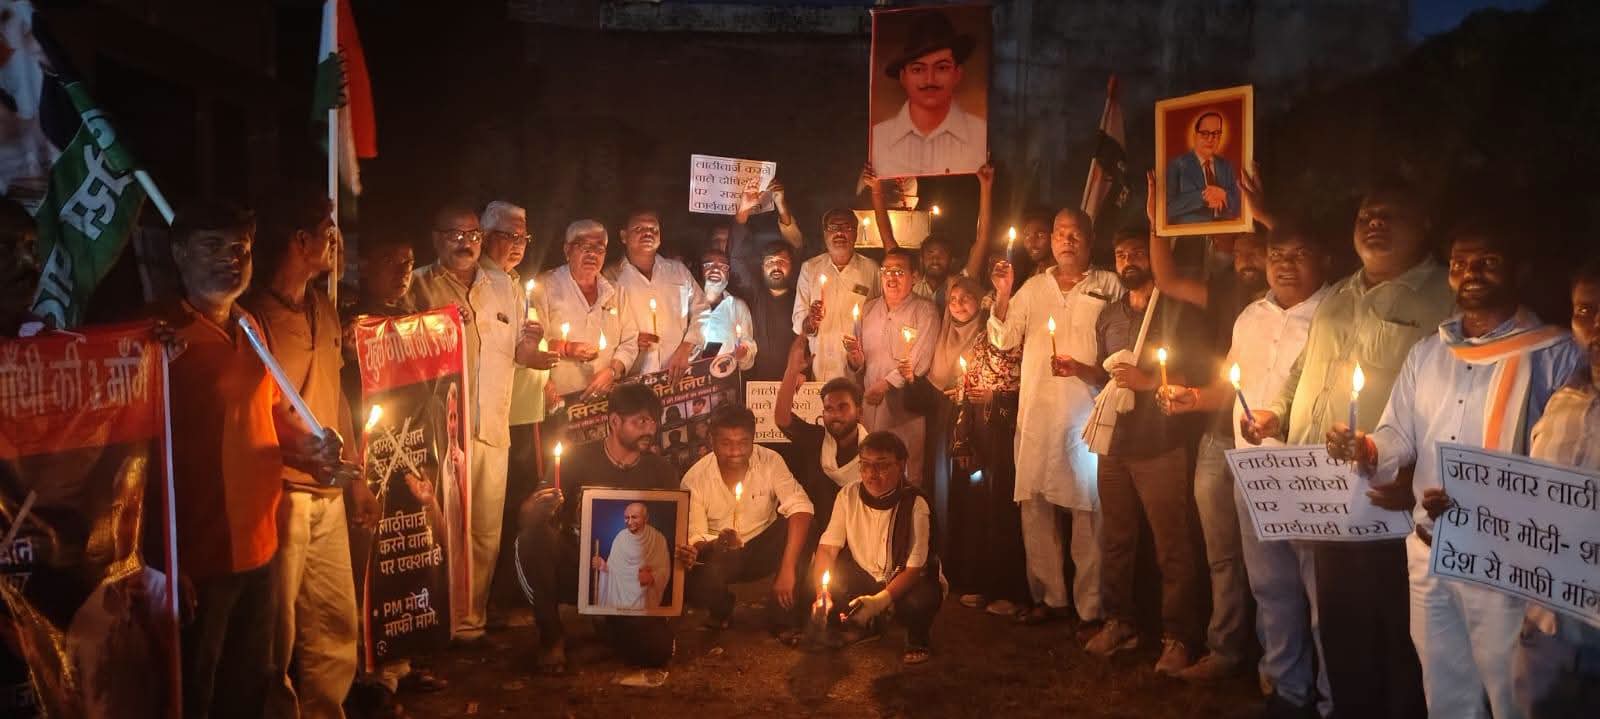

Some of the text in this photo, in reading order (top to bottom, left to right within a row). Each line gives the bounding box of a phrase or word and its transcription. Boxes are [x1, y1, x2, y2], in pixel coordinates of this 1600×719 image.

[1238, 452, 1317, 470] लाठीचार्ज
[1246, 475, 1349, 492] वाले दोषियों
[1447, 453, 1490, 486] जंतर
[1497, 463, 1540, 497] मंतर
[378, 506, 428, 535] लाठीचार्ज
[1254, 501, 1350, 515] पर सख्त
[1447, 498, 1472, 527] के
[1476, 506, 1512, 543] लिए
[1263, 520, 1390, 536] कार्यवाही करो
[379, 532, 406, 555] करने
[380, 558, 396, 576] पर
[397, 550, 432, 572] एक्शन
[1441, 541, 1477, 574] देश
[1484, 551, 1502, 581] से
[1509, 566, 1555, 599] माफी
[383, 587, 430, 617] PM मोदी
